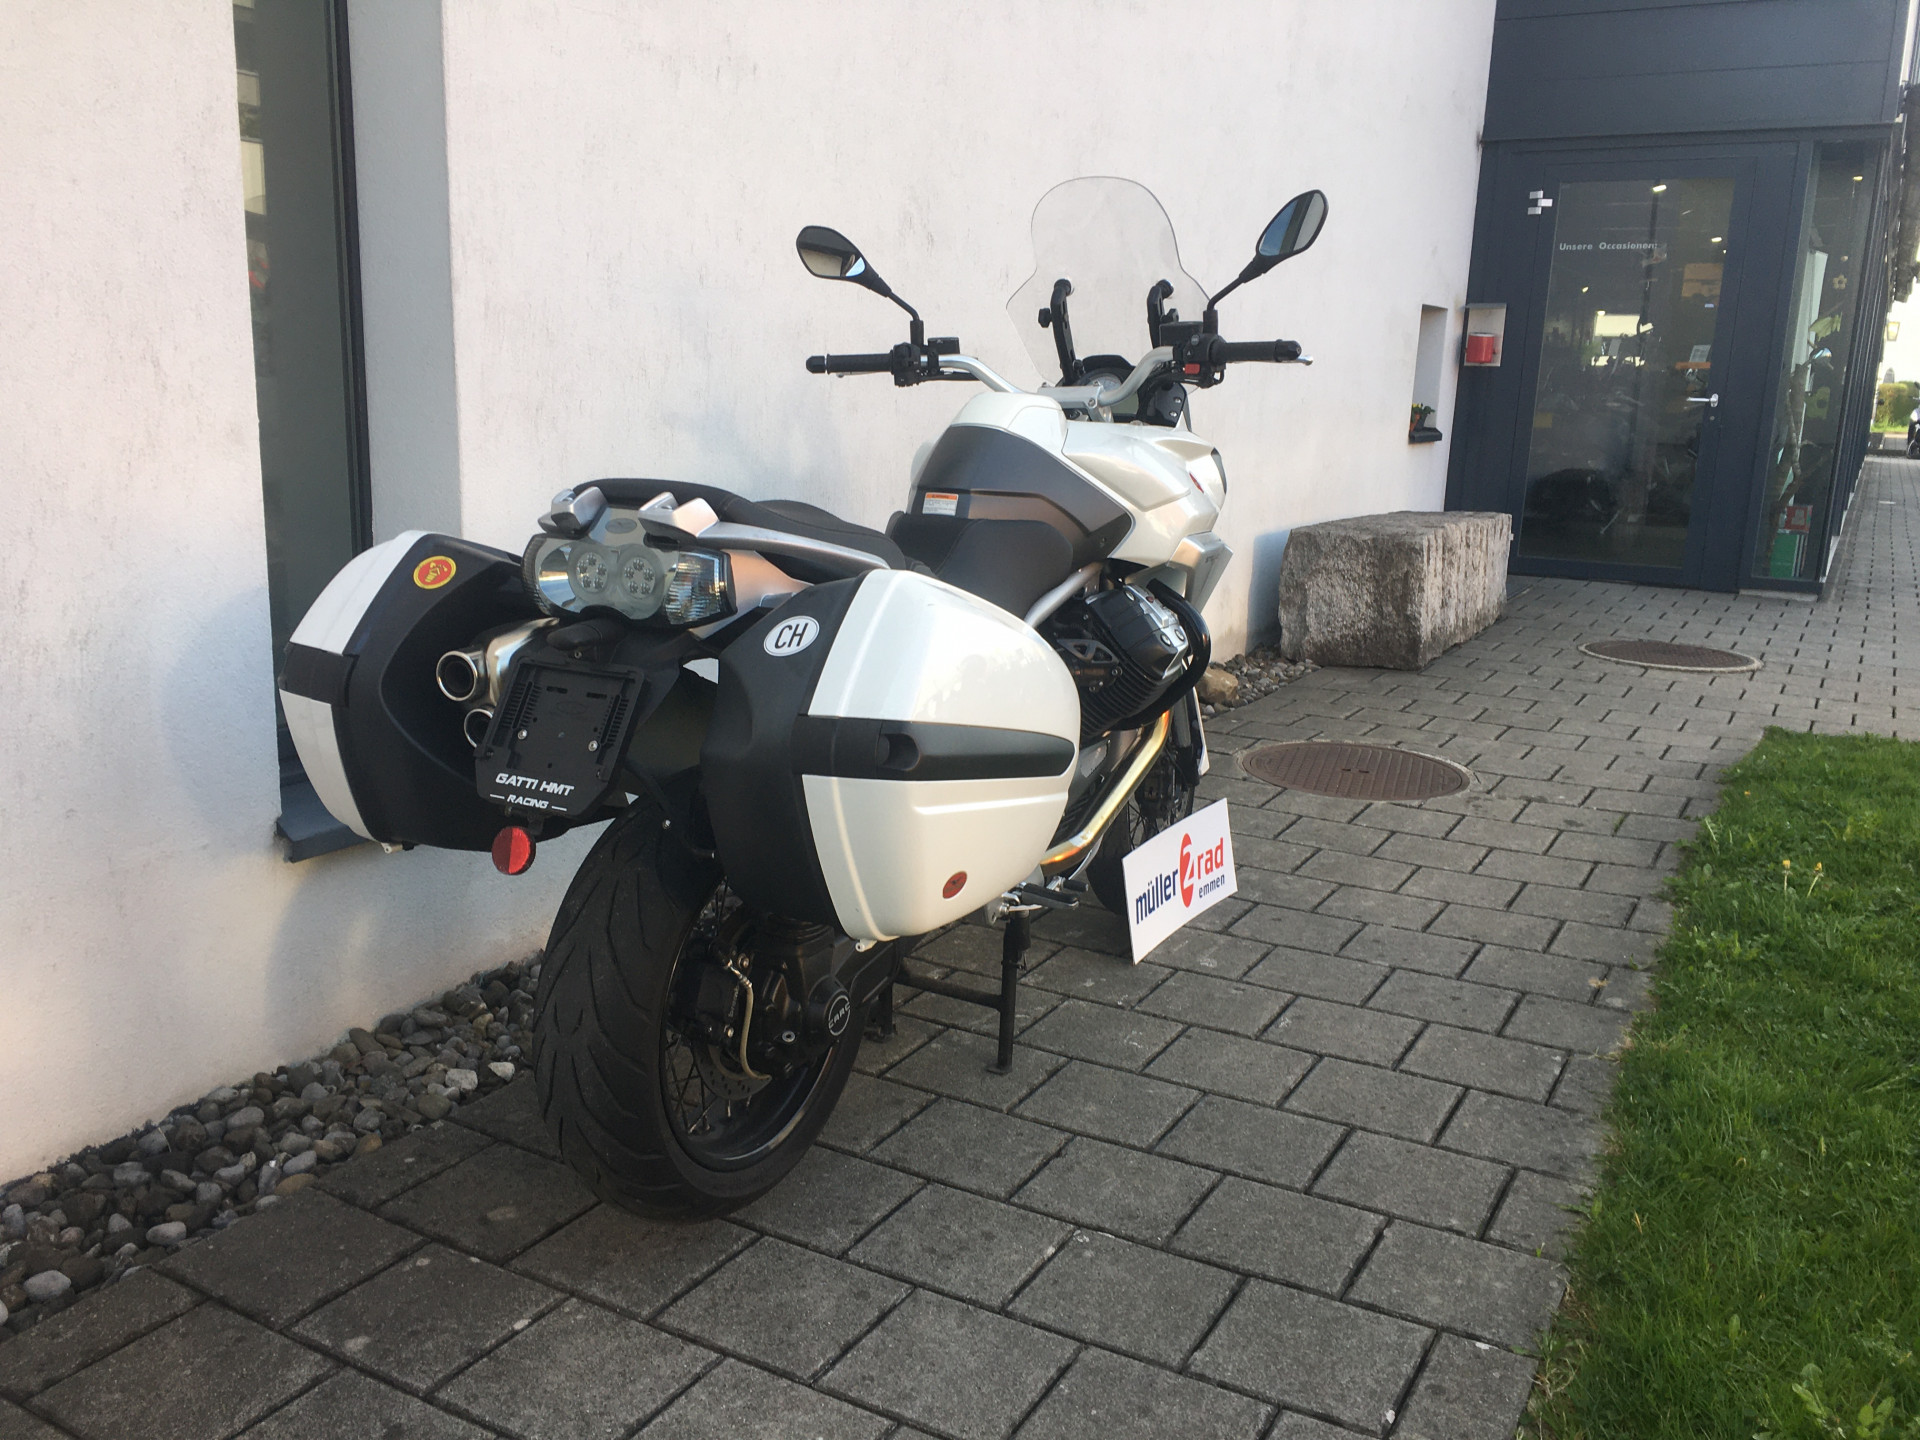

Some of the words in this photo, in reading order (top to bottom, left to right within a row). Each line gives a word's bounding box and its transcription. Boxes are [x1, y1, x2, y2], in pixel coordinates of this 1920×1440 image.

[1559, 242, 1593, 251] Unsere
[774, 622, 809, 649] CH
[495, 772, 539, 790] GATTI
[540, 780, 575, 796] HMT
[507, 794, 550, 809] RACING
[1198, 873, 1226, 899] emmen
